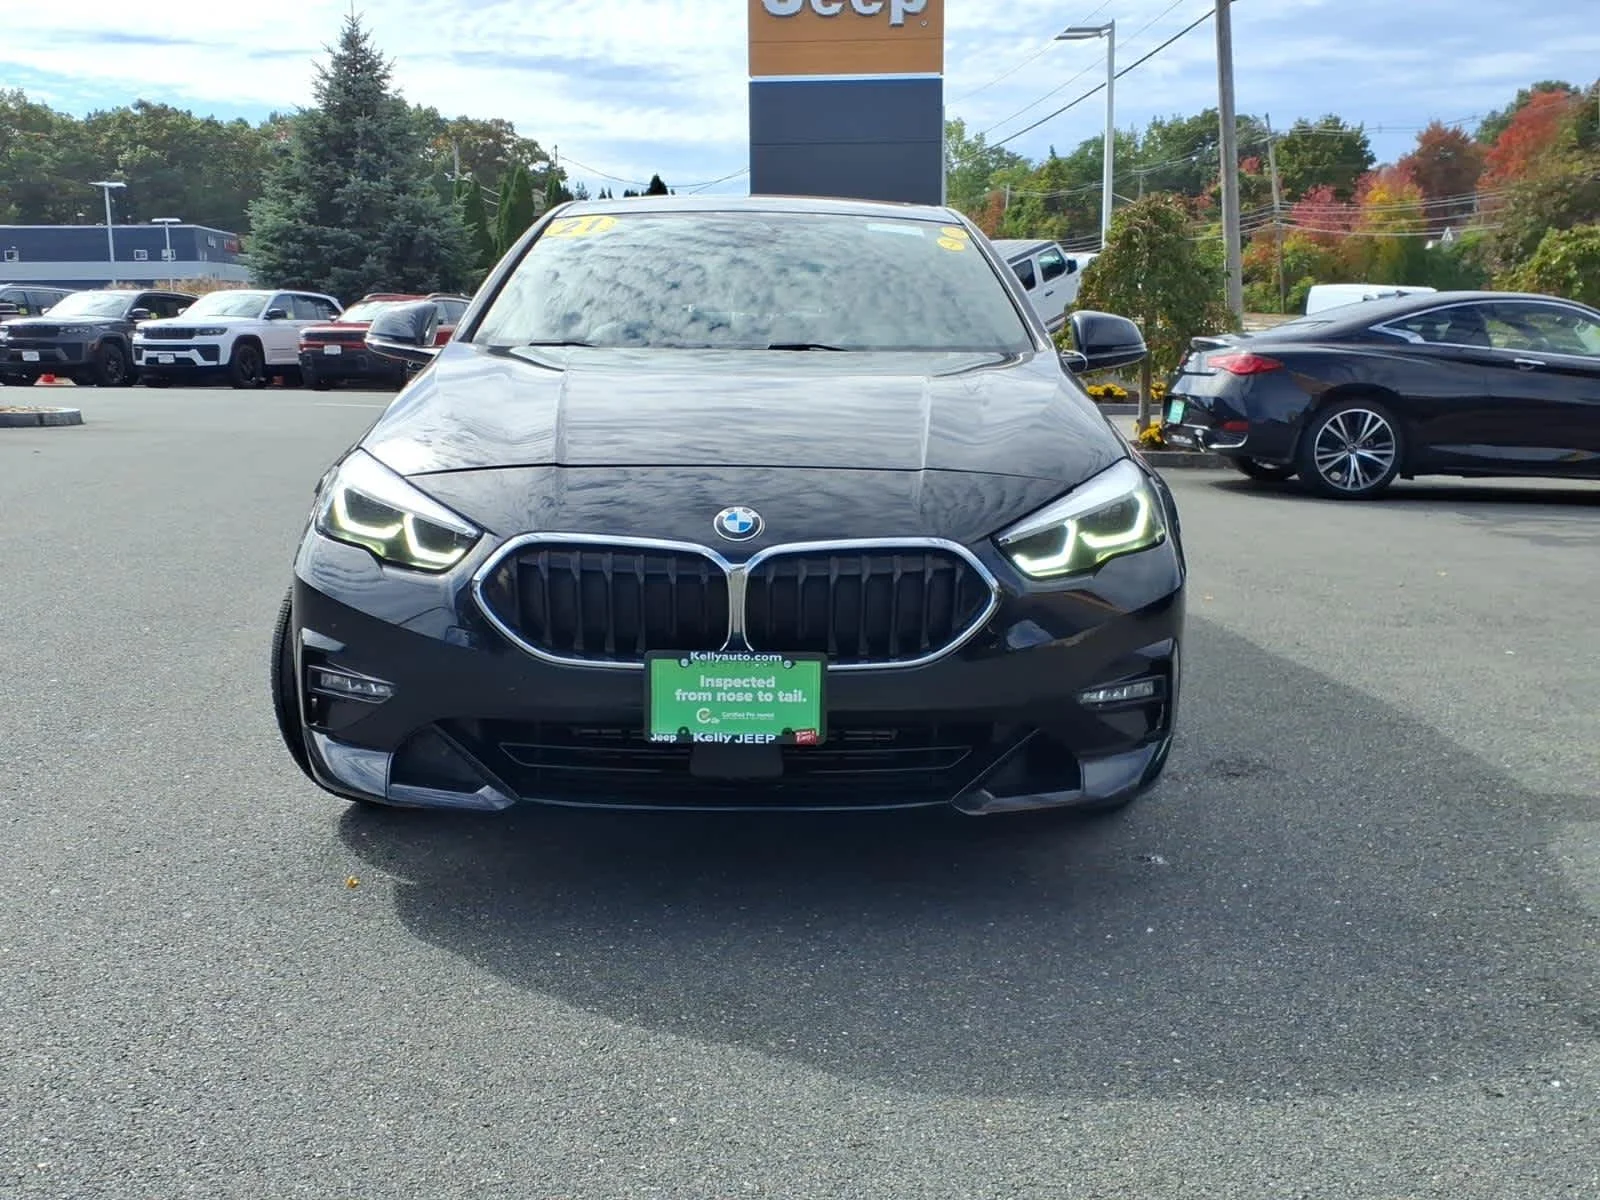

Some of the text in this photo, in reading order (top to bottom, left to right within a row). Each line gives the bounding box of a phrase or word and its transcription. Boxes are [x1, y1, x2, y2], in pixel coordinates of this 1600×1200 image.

[690, 651, 782, 662] Kellyauto.com
[700, 675, 776, 690] Inspected
[675, 689, 807, 703] from nose to tail.
[650, 733, 677, 743] Jeep
[693, 732, 776, 744] Kelly JEEP
